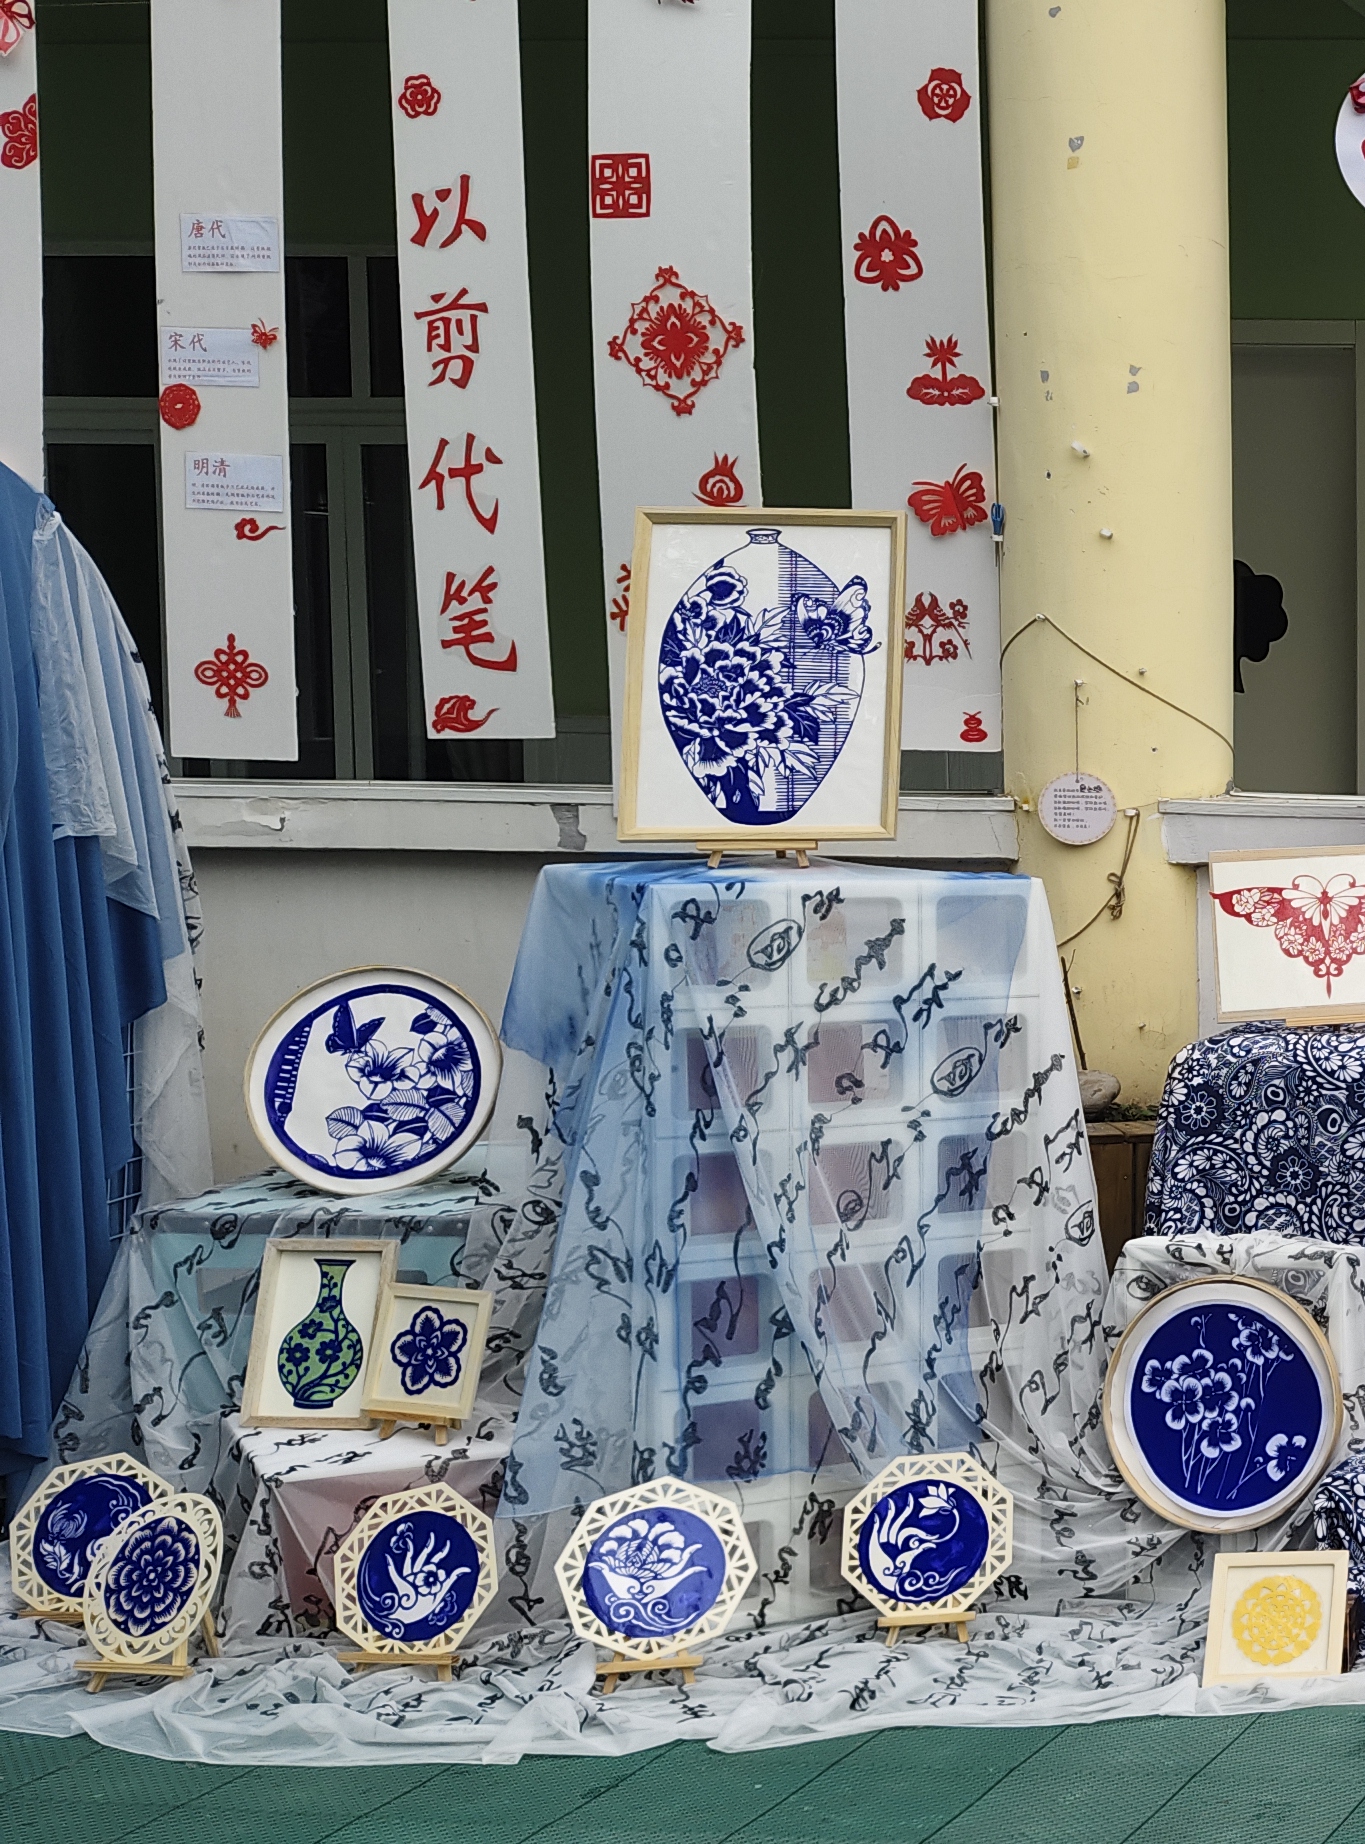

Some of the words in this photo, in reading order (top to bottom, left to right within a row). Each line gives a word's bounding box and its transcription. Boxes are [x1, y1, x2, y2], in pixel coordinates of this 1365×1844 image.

[187, 219, 226, 239] 唐代
[167, 331, 208, 353] 宋代
[411, 173, 518, 673] 以剪代笔
[193, 458, 231, 478] 明清
